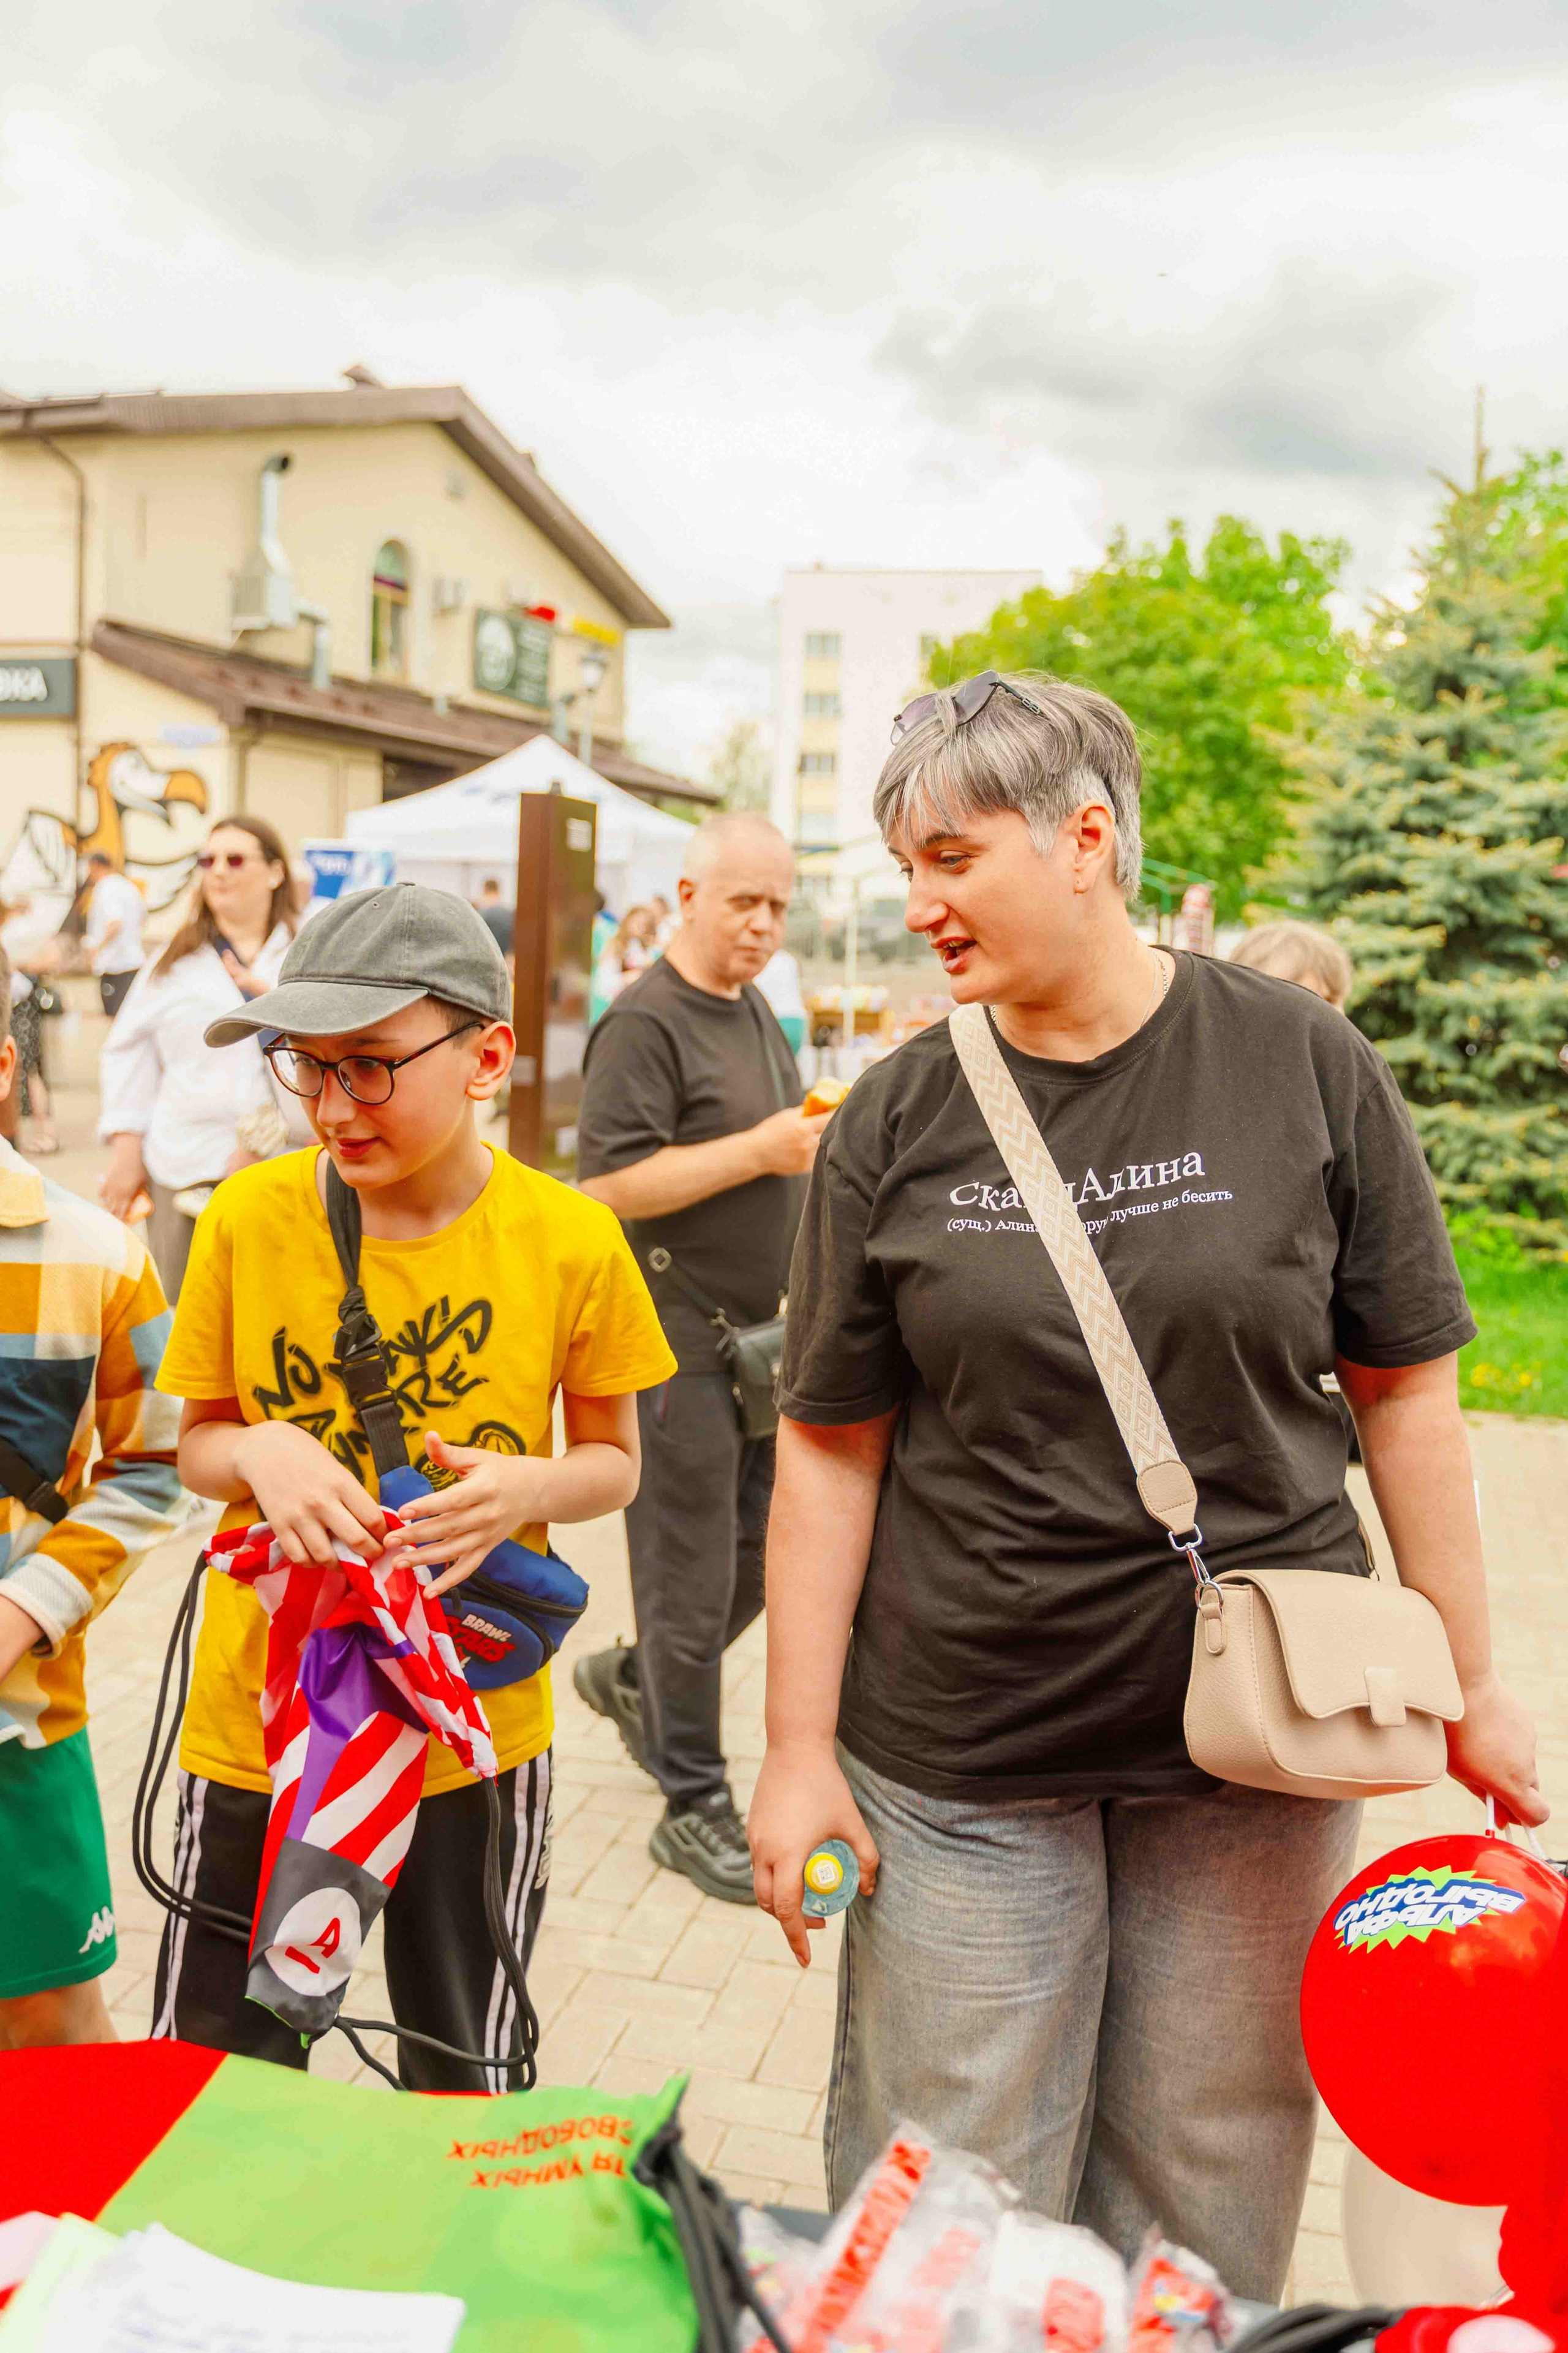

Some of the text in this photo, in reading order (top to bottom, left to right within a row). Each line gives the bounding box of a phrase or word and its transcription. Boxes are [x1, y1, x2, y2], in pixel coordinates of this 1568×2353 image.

[949, 1151, 1205, 1211] СкаАлина
[947, 1218, 992, 1233] (сущ.)
[995, 1220, 1039, 1233] Алин
[1110, 1203, 1159, 1223] лучше
[1162, 1196, 1178, 1210] не
[1182, 1189, 1233, 1204] бесить
[1334, 1881, 1526, 1932] ВЫГОДНО
[1346, 1903, 1487, 1946] АЛЬФА
[470, 2154, 584, 2188] УМНЫХ
